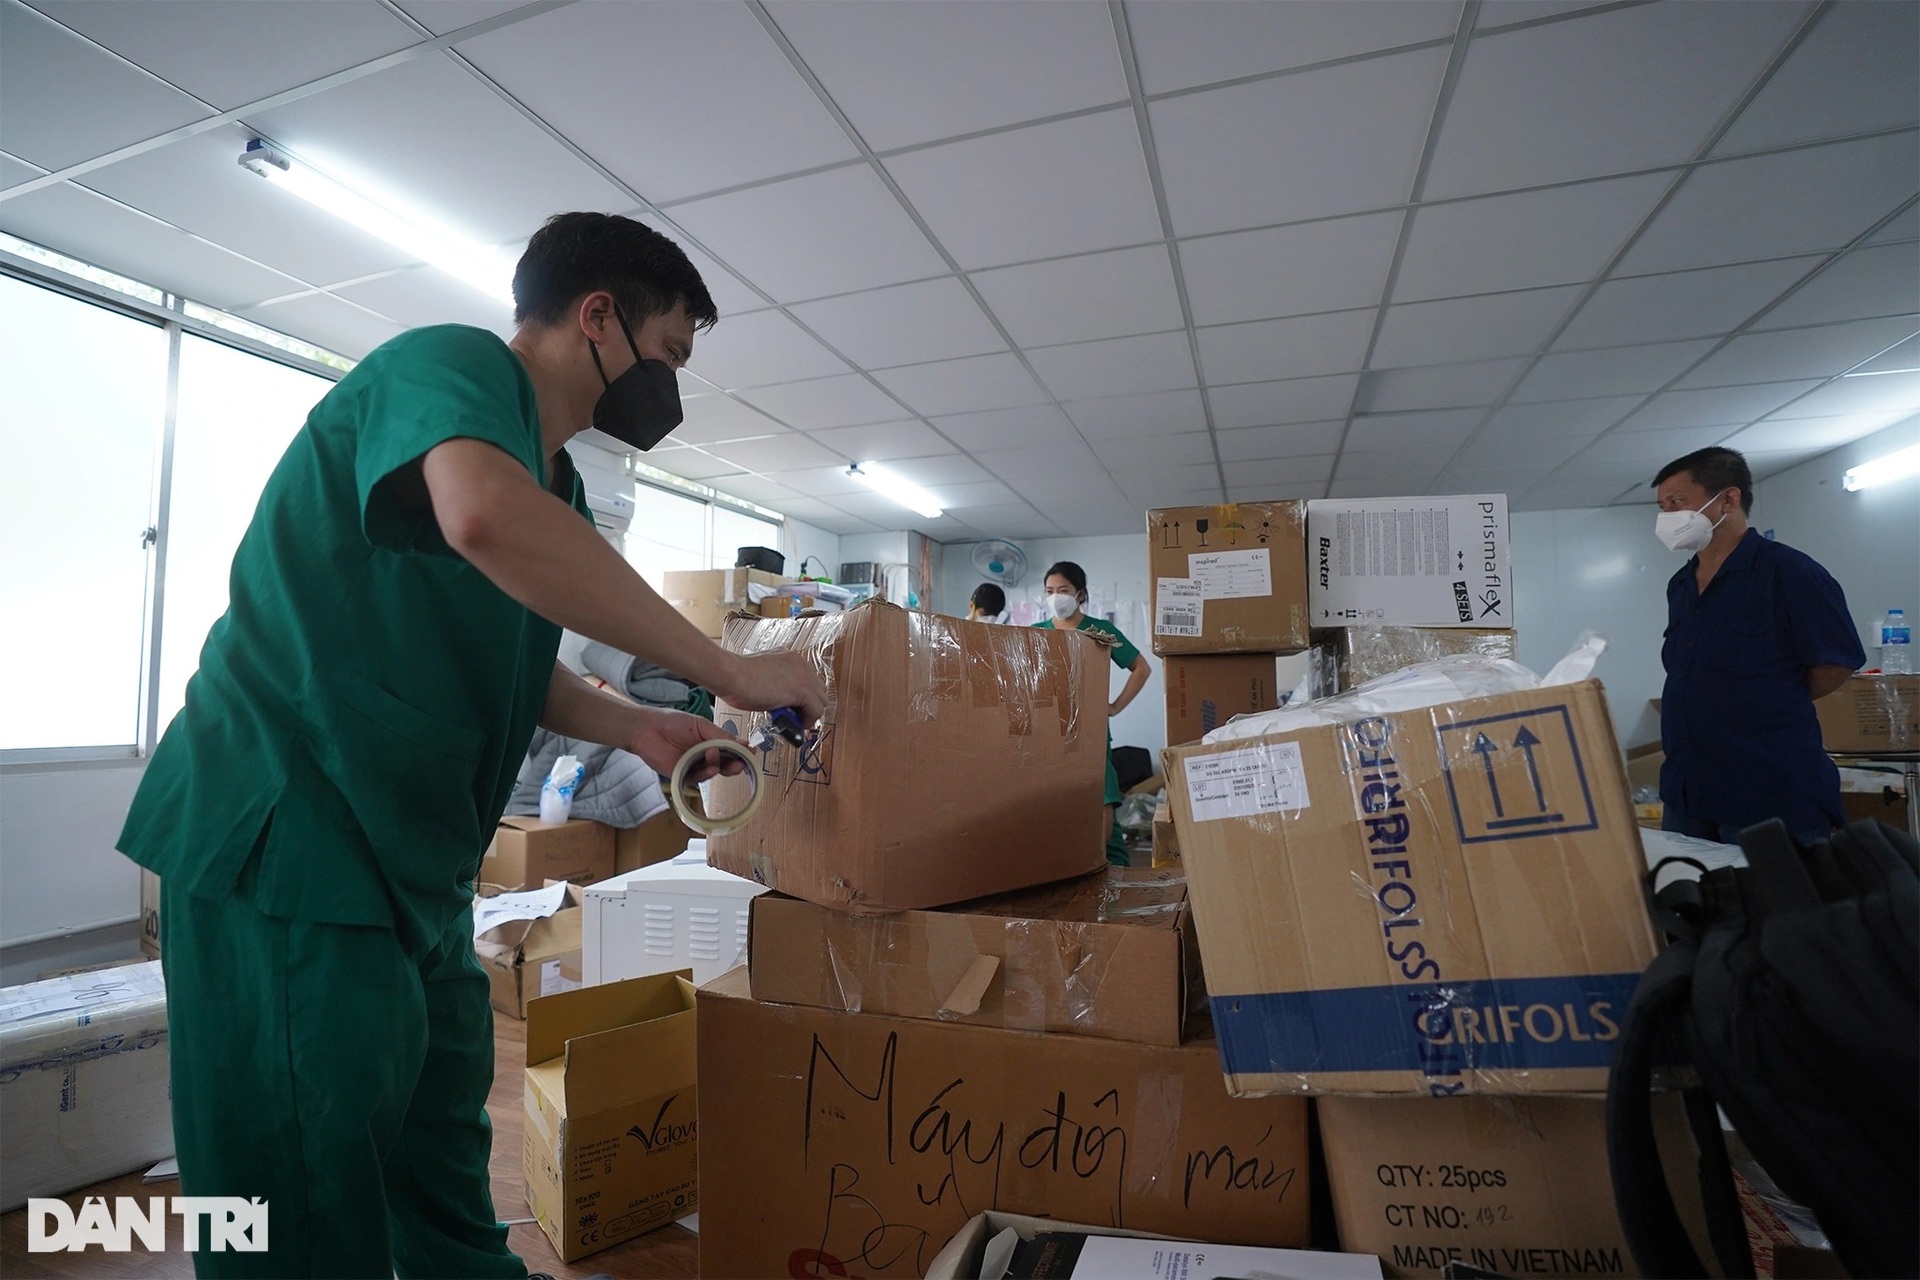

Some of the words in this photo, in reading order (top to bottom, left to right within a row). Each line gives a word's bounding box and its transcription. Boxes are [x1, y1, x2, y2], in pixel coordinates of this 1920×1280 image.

[1319, 536, 1330, 590] Baxter
[1456, 594, 1473, 620] SETS
[1418, 1003, 1620, 1046] GRIFOLS
[1377, 1164, 1434, 1187] QTY:
[1438, 1165, 1507, 1192] 25pcs
[1385, 1204, 1415, 1227] CT
[1424, 1206, 1469, 1229] NO:
[1502, 1248, 1624, 1273] VIETNAM
